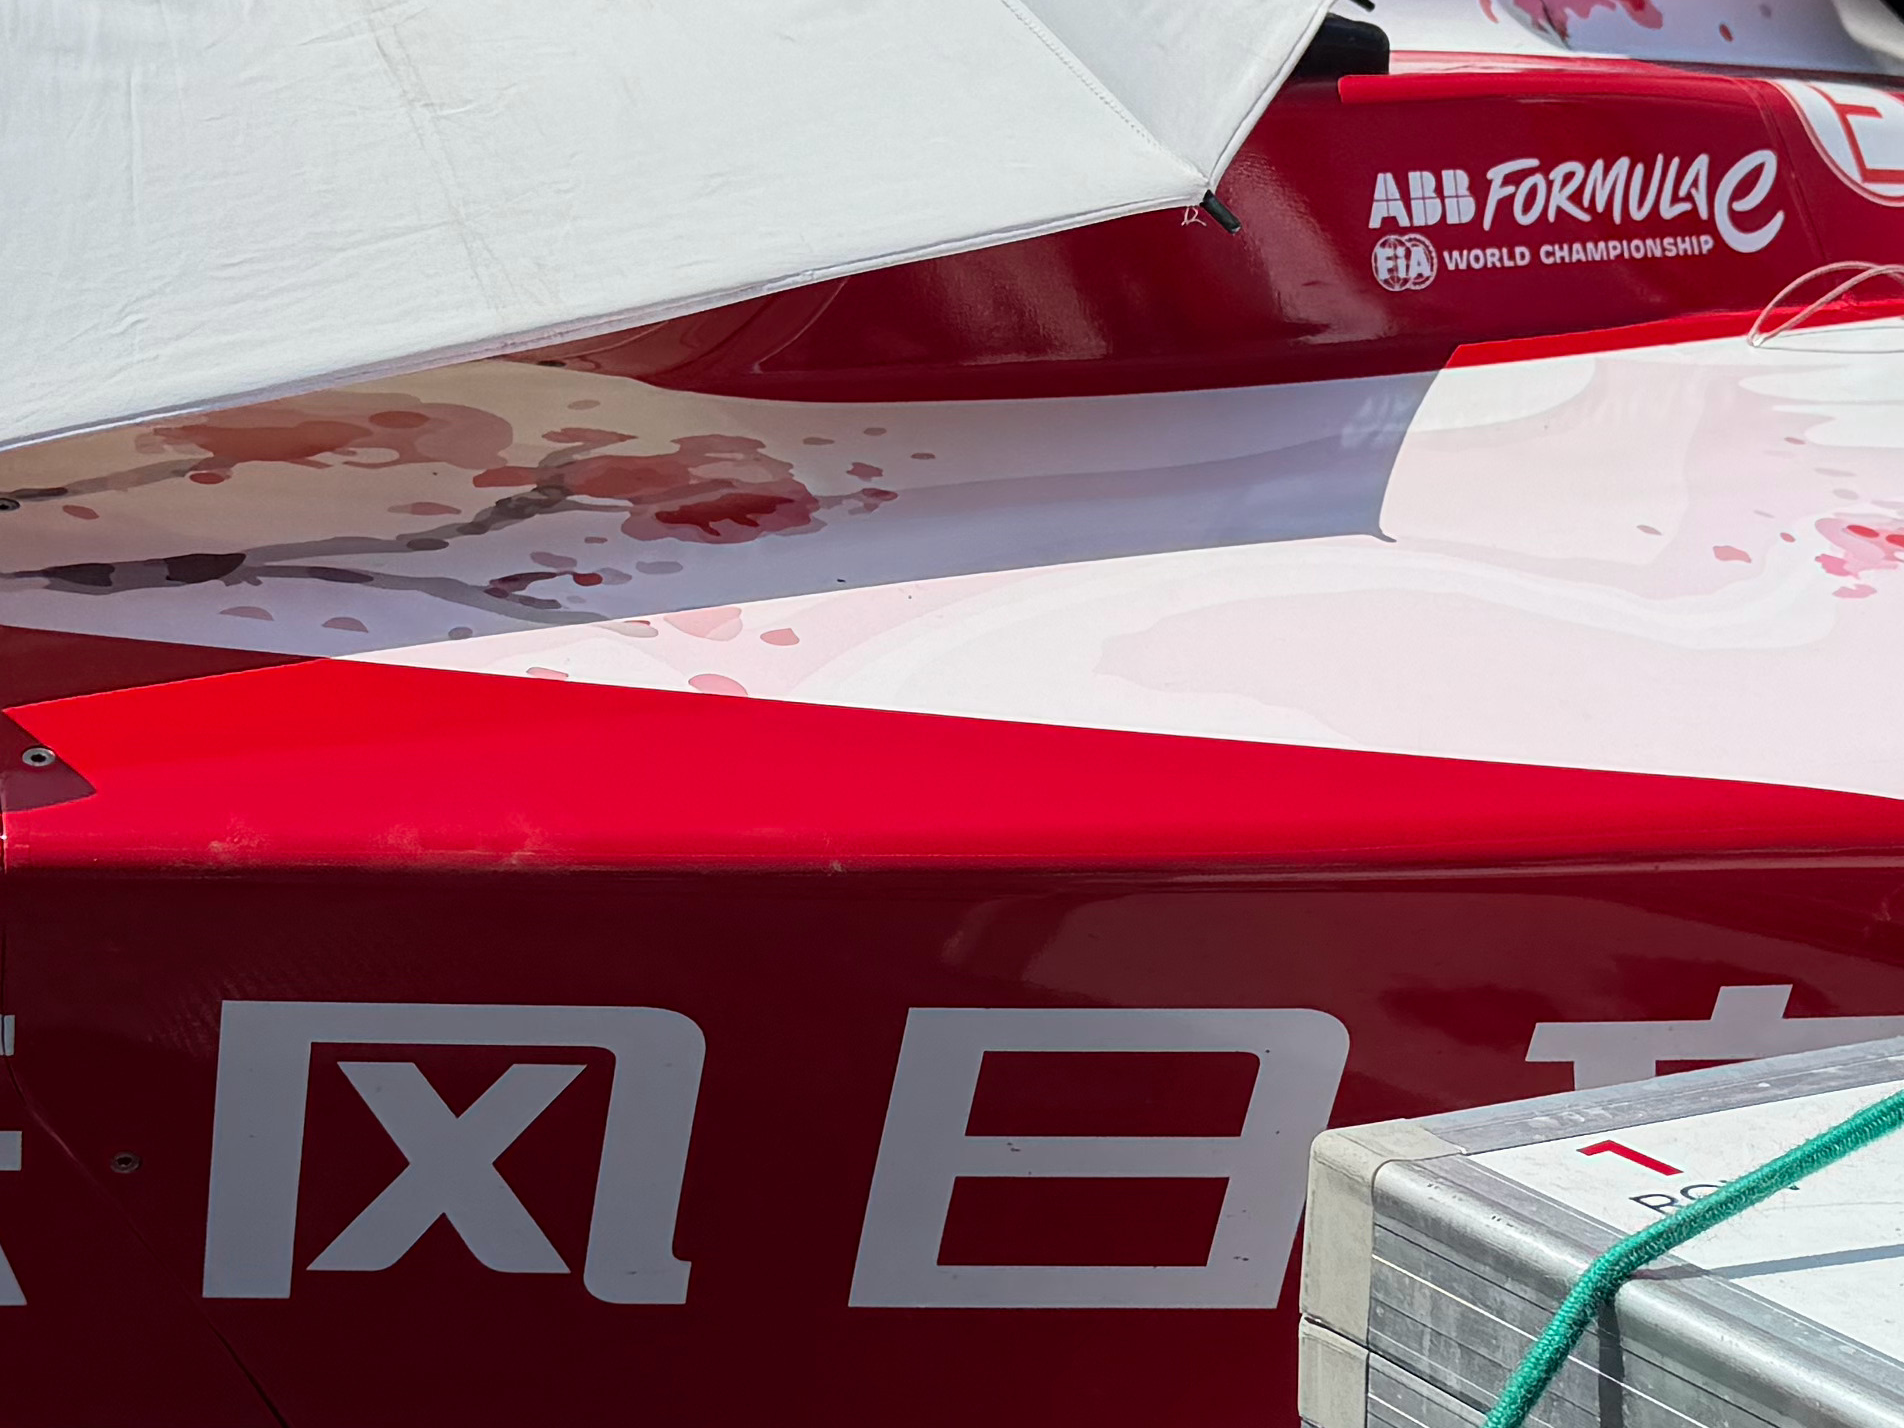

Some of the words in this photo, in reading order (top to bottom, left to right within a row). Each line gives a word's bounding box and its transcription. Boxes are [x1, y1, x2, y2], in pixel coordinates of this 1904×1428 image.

[1369, 169, 1477, 230] ABB
[1482, 152, 1710, 231] FORMULA
[1443, 241, 1530, 271] WORLD
[1539, 235, 1714, 265] CHAMPIONSHIP
